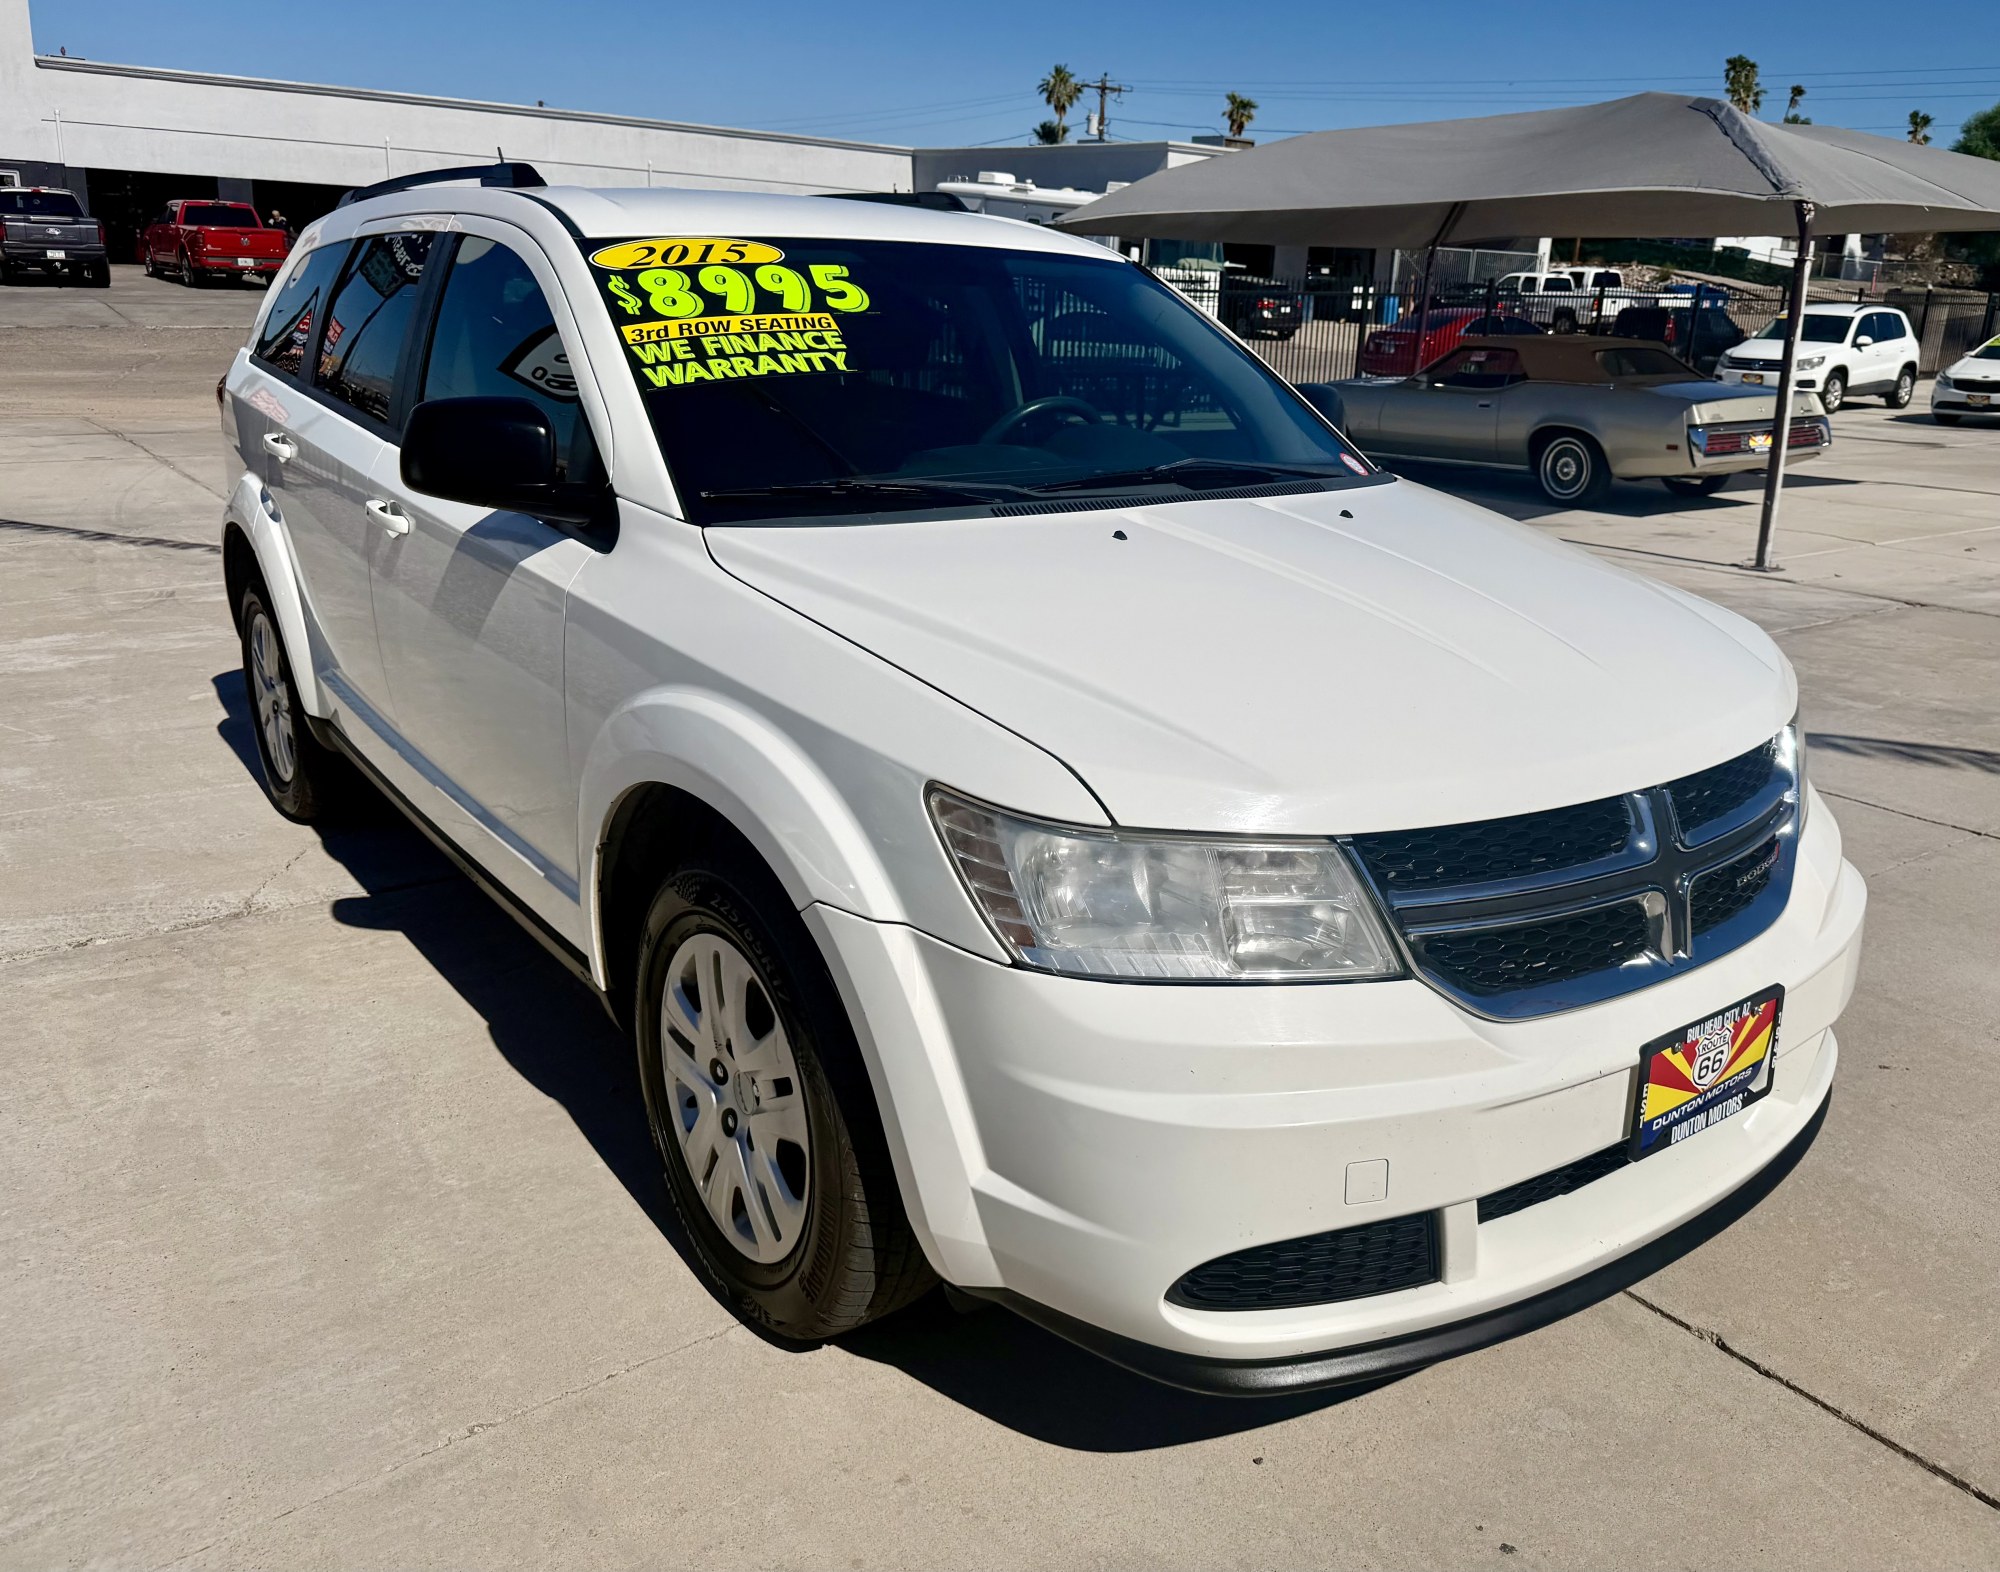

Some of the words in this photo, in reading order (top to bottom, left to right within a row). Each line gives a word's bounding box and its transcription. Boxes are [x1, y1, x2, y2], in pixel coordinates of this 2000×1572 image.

[627, 243, 750, 267] 2015
[608, 264, 870, 319] $8995
[631, 325, 669, 342] 3rd
[678, 320, 731, 335] ROW
[740, 317, 832, 332] SEATING
[630, 339, 695, 364] WE
[700, 331, 847, 356] FINANCE
[641, 352, 848, 387] WARRANTY
[1687, 1015, 1723, 1043] BULLHEAD
[1742, 1001, 1751, 1018] AZ
[1701, 1033, 1728, 1053] ROUTE
[1698, 1049, 1725, 1080] 66
[1652, 1095, 1705, 1130] DUNTON
[1705, 1067, 1752, 1102] MOTORS
[1670, 1111, 1707, 1144] DUNTON
[1708, 1093, 1743, 1126] MOTORS
